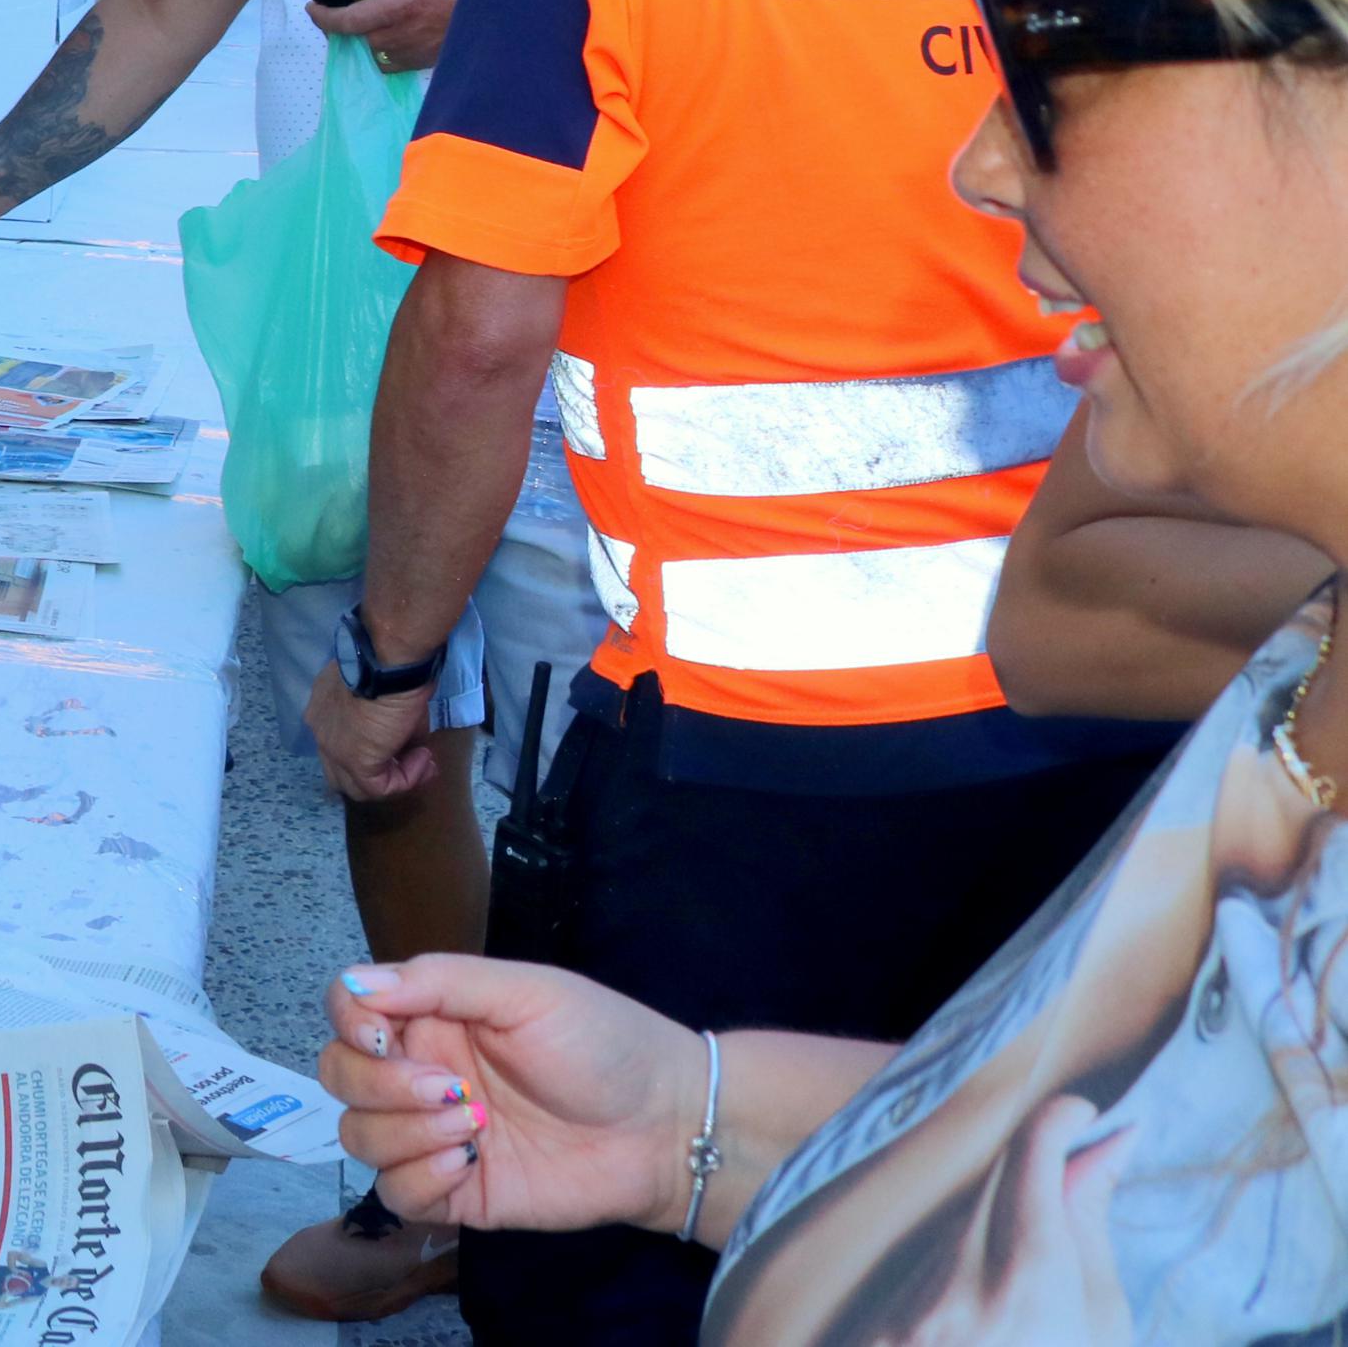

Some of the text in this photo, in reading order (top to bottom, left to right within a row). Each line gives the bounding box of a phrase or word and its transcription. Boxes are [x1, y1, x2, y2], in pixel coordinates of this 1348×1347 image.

[31, 1070, 45, 1119] CHUMI
[72, 1063, 122, 1128] El
[193, 1079, 218, 1090] los
[211, 1066, 234, 1081] por
[11, 1071, 32, 1247] AL ANDORRA DE LEZCANO
[35, 1120, 48, 1178] ORTEGA
[34, 1179, 47, 1197] SE
[72, 1130, 125, 1258] Norte
[60, 1264, 115, 1302] de
